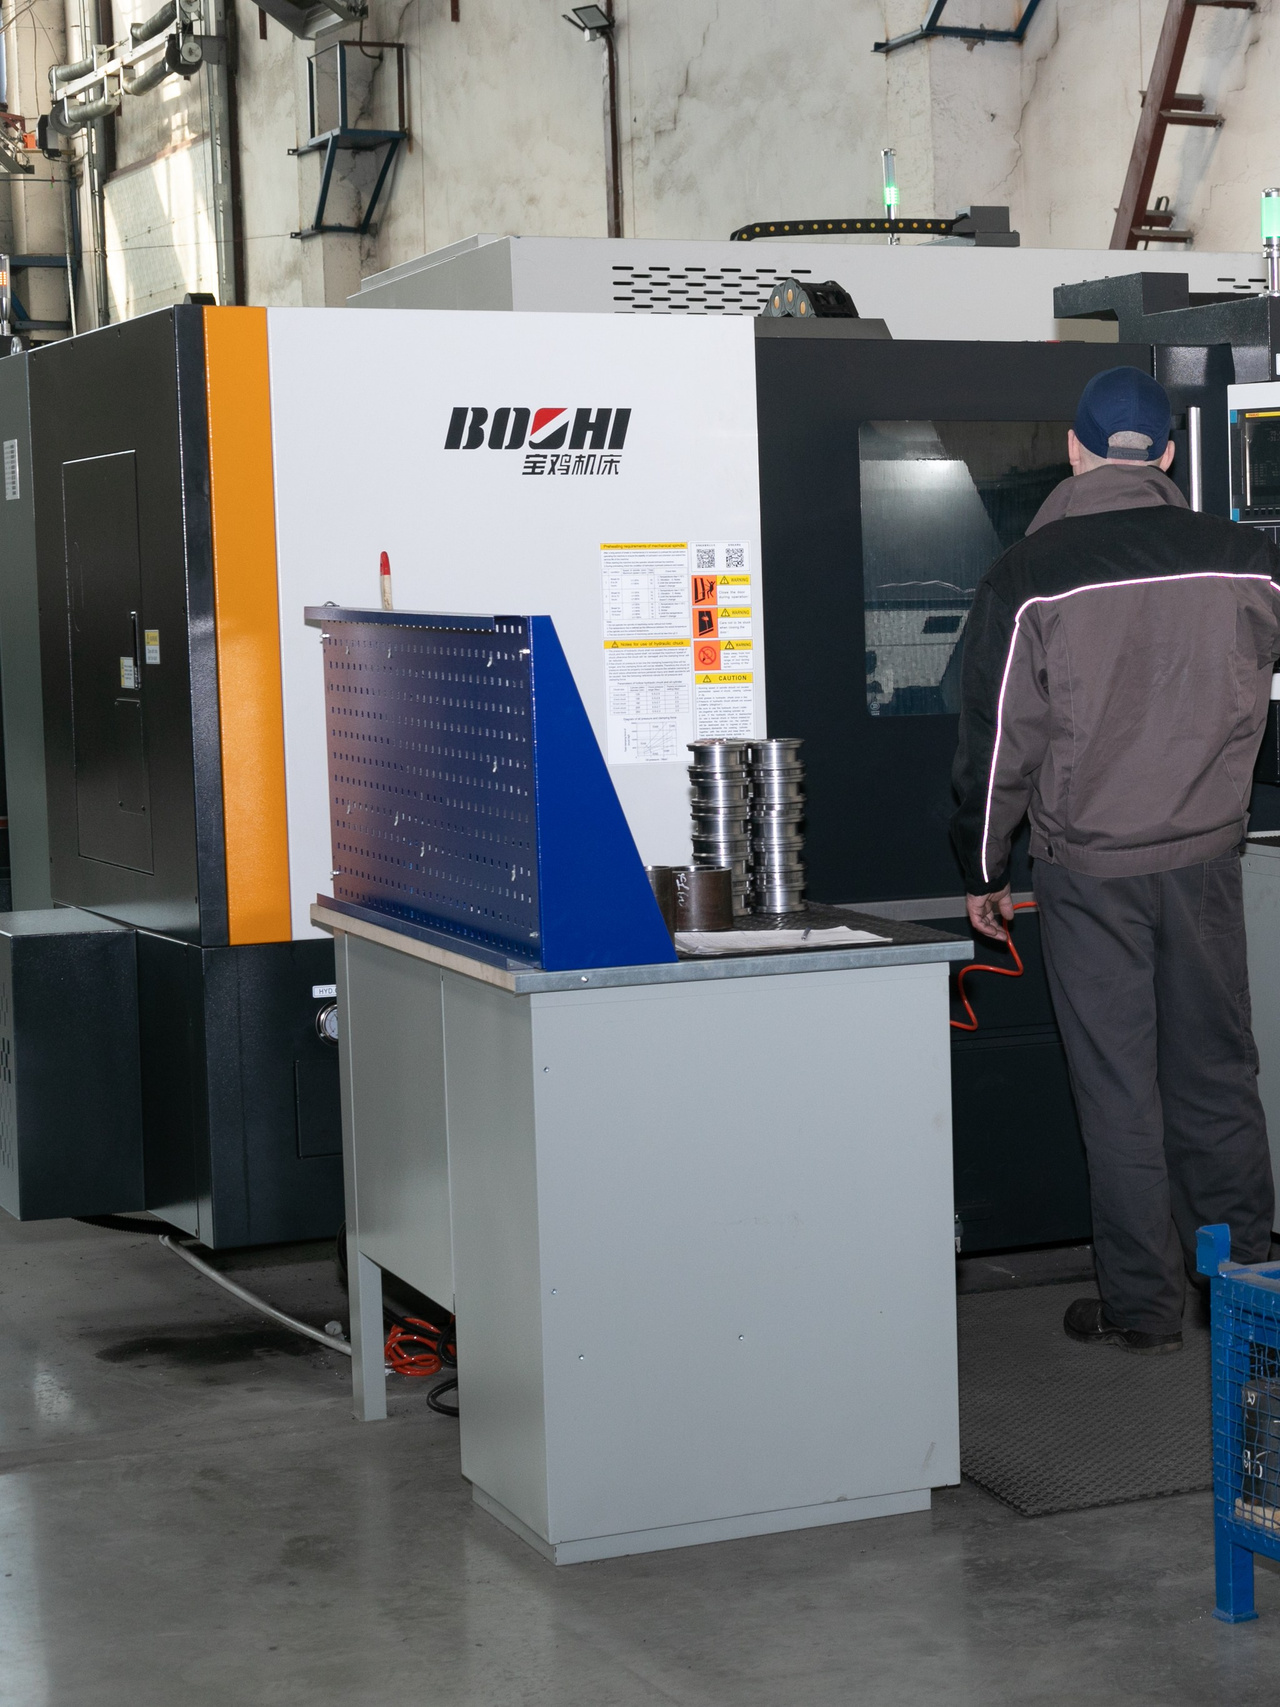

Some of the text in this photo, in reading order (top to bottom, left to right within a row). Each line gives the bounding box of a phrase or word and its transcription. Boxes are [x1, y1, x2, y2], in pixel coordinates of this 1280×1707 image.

[444, 407, 632, 450] BOSHI
[522, 454, 622, 475] 宝鸡机床
